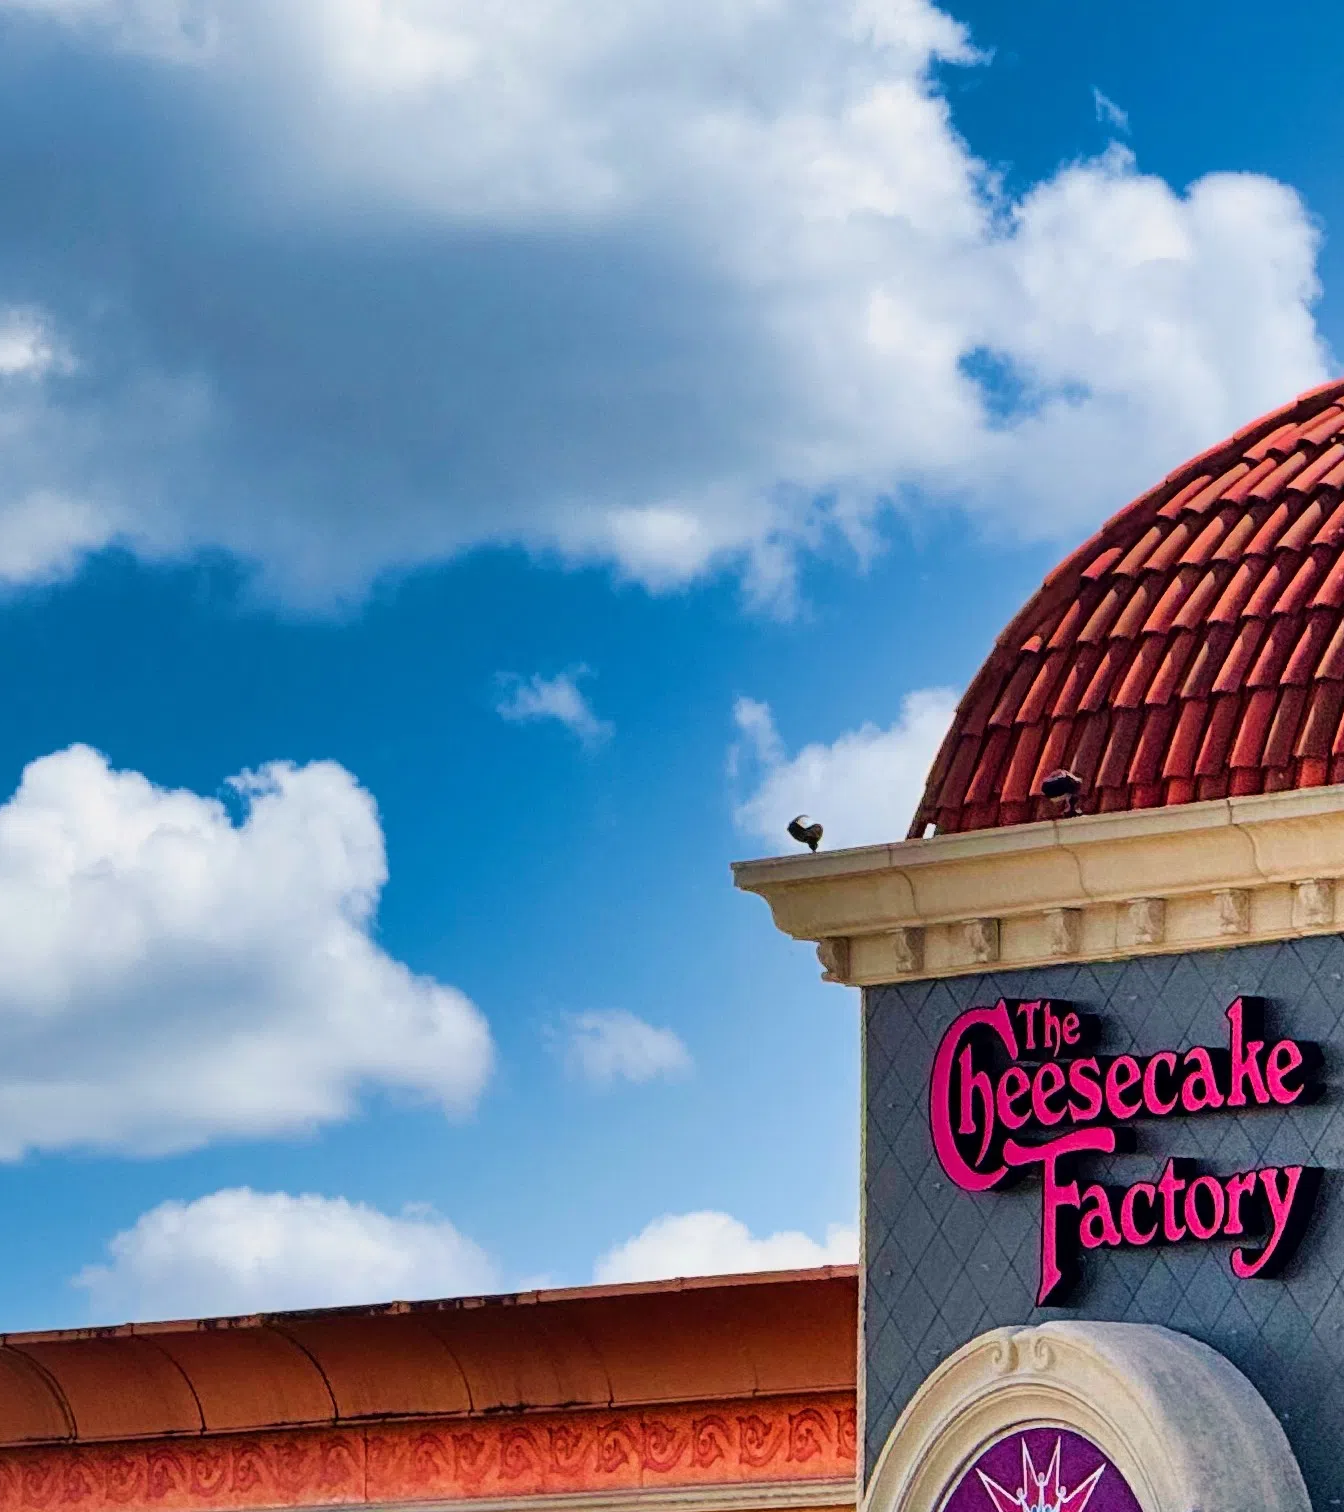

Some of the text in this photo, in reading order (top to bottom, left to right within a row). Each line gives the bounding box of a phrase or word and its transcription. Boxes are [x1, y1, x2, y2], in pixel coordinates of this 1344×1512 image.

[929, 996, 1306, 1193] Cheesecake
[1016, 1000, 1082, 1057] The
[1002, 1126, 1304, 1308] Factory
